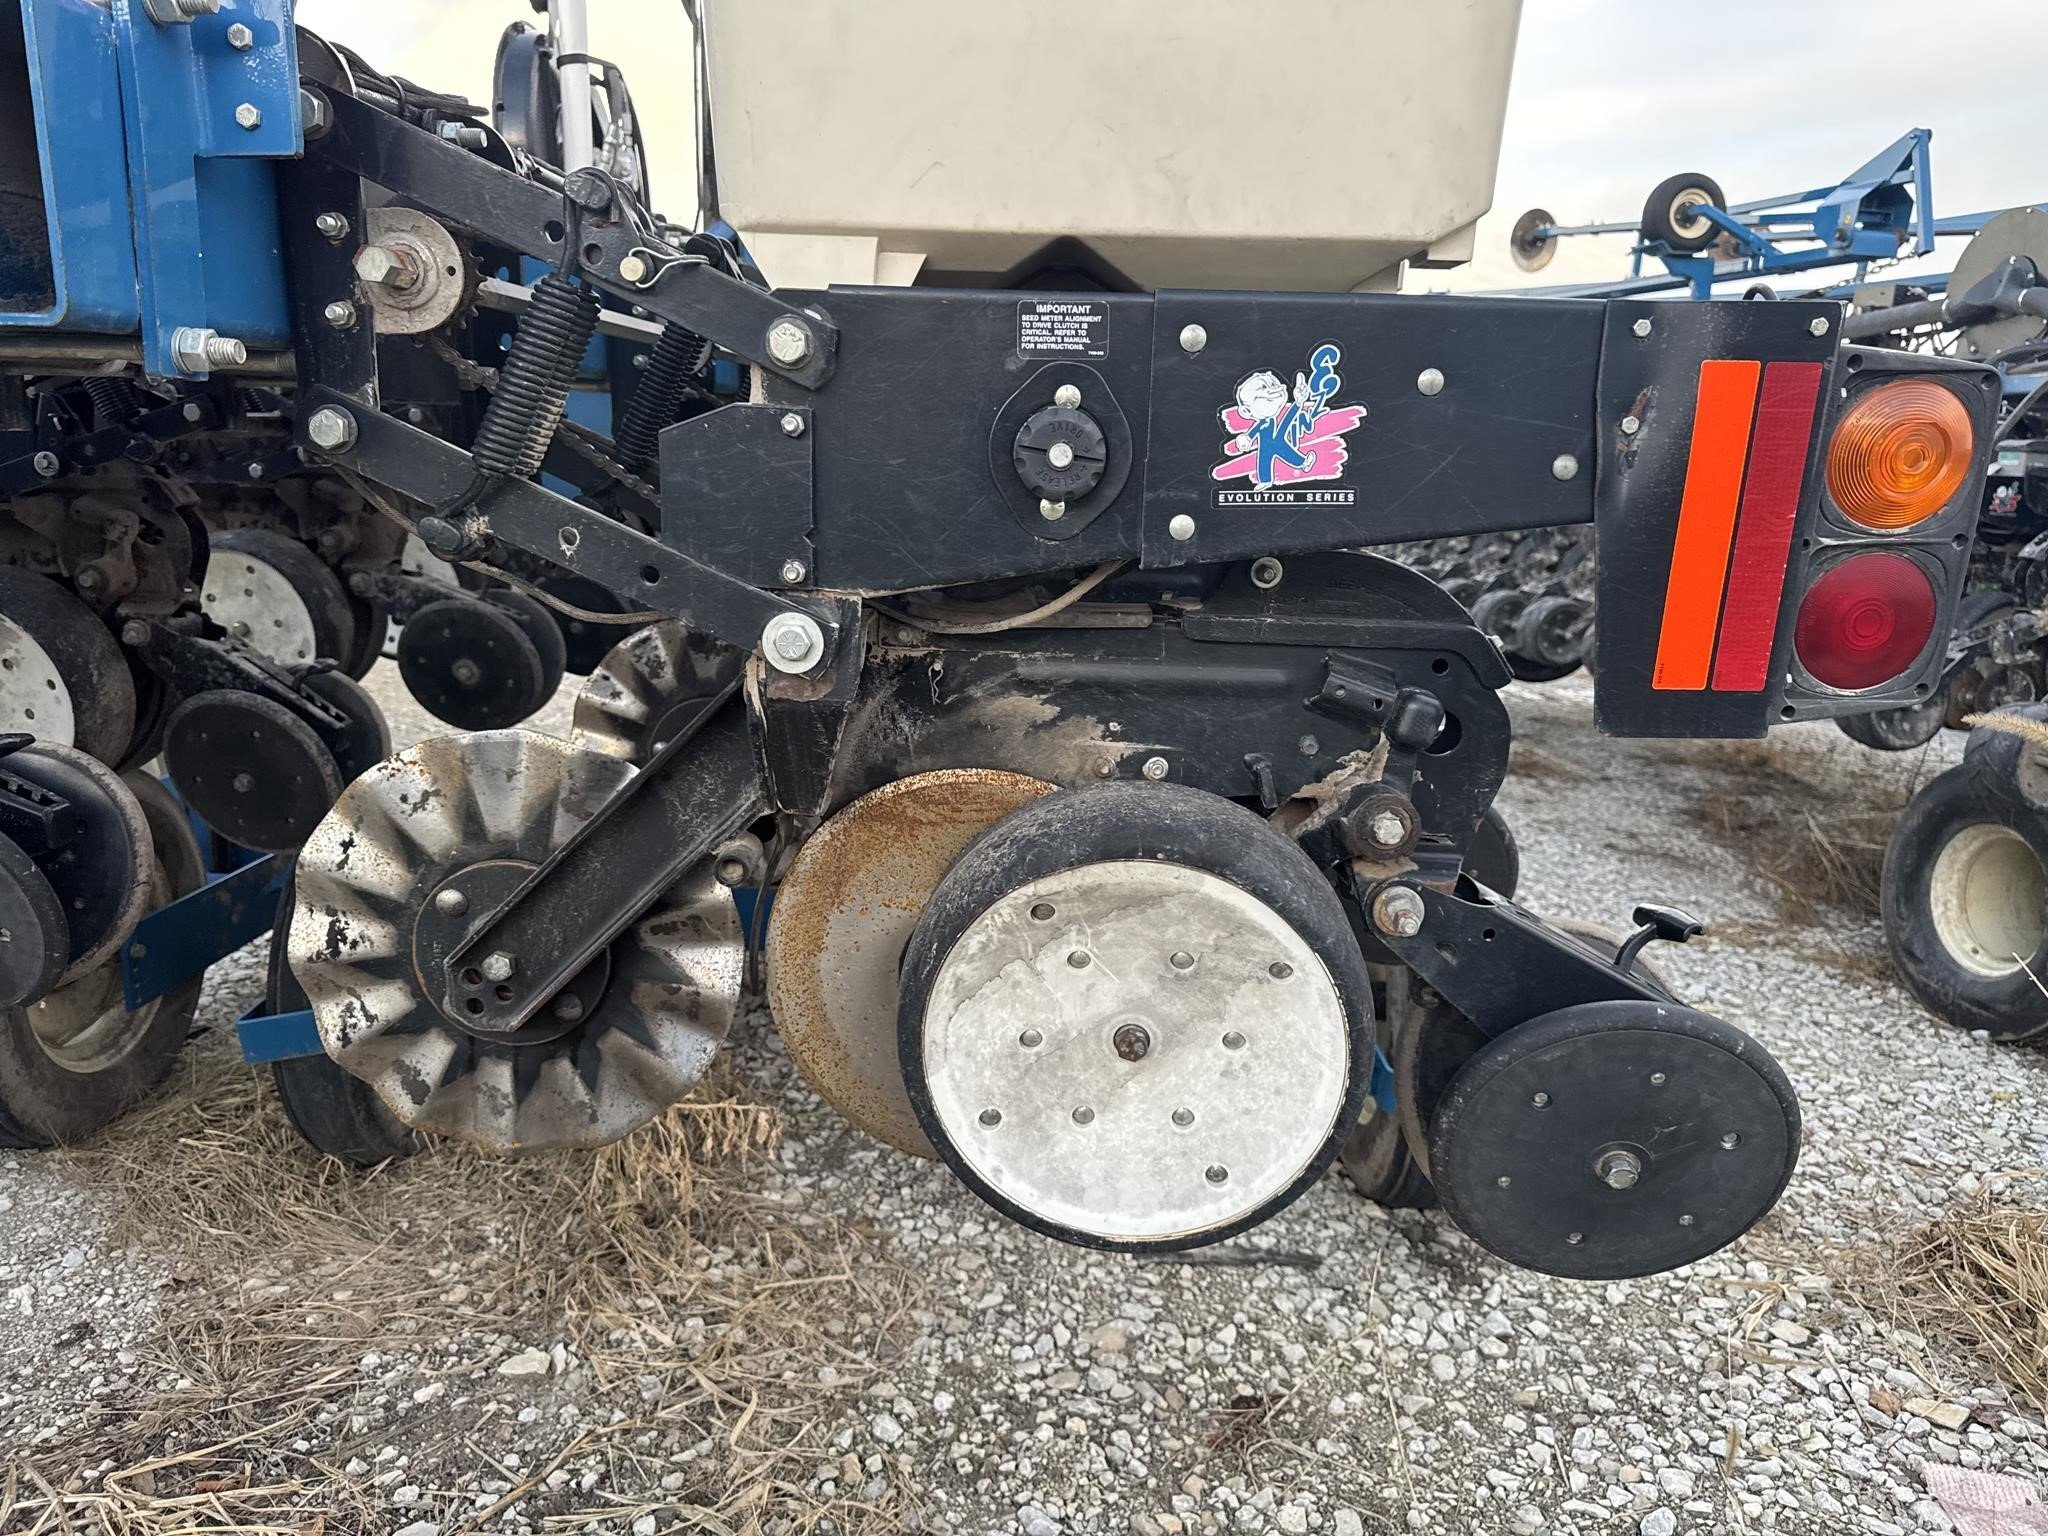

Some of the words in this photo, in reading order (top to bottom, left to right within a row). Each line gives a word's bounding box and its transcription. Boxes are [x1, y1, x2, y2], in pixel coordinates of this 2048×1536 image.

[1036, 304, 1092, 314] IMPORTANT
[1218, 492, 1295, 503] EVOLUTION
[1306, 493, 1355, 502] SERIES
